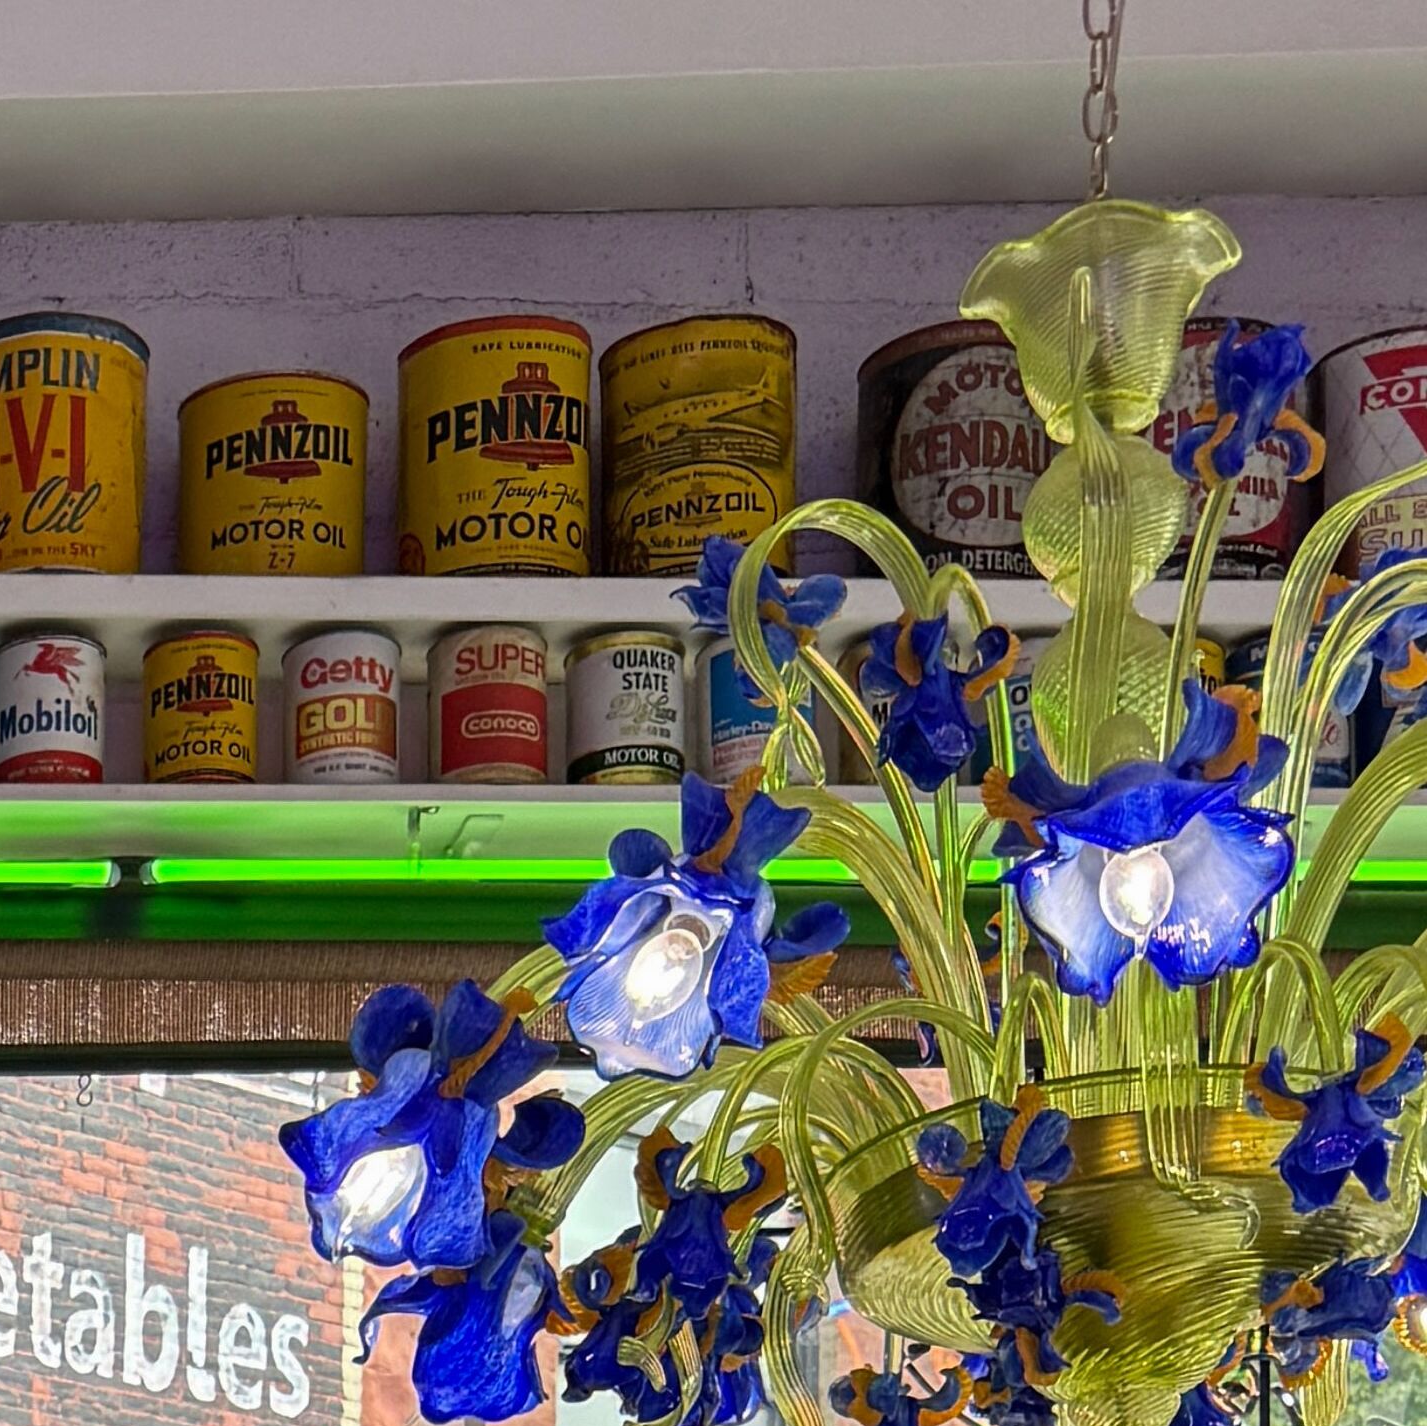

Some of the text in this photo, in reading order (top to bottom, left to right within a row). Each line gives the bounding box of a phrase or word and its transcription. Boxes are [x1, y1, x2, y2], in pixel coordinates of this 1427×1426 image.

[205, 422, 354, 480] PENNZOIL
[630, 492, 766, 534] PENNZOIL
[945, 483, 1024, 522] OIL
[210, 518, 346, 551] MOTOR OIL
[435, 511, 558, 552] MOTOR
[300, 657, 395, 693] Getty
[455, 643, 547, 682] SUPER
[612, 649, 676, 672] QUAKER
[151, 673, 255, 718] PENNZOIL
[622, 672, 669, 693] STATE
[0, 698, 99, 744] Mobiloil
[466, 716, 538, 737] conoco
[155, 740, 253, 766] MOTOR OIL
[603, 747, 681, 769] MOTOR OIL
